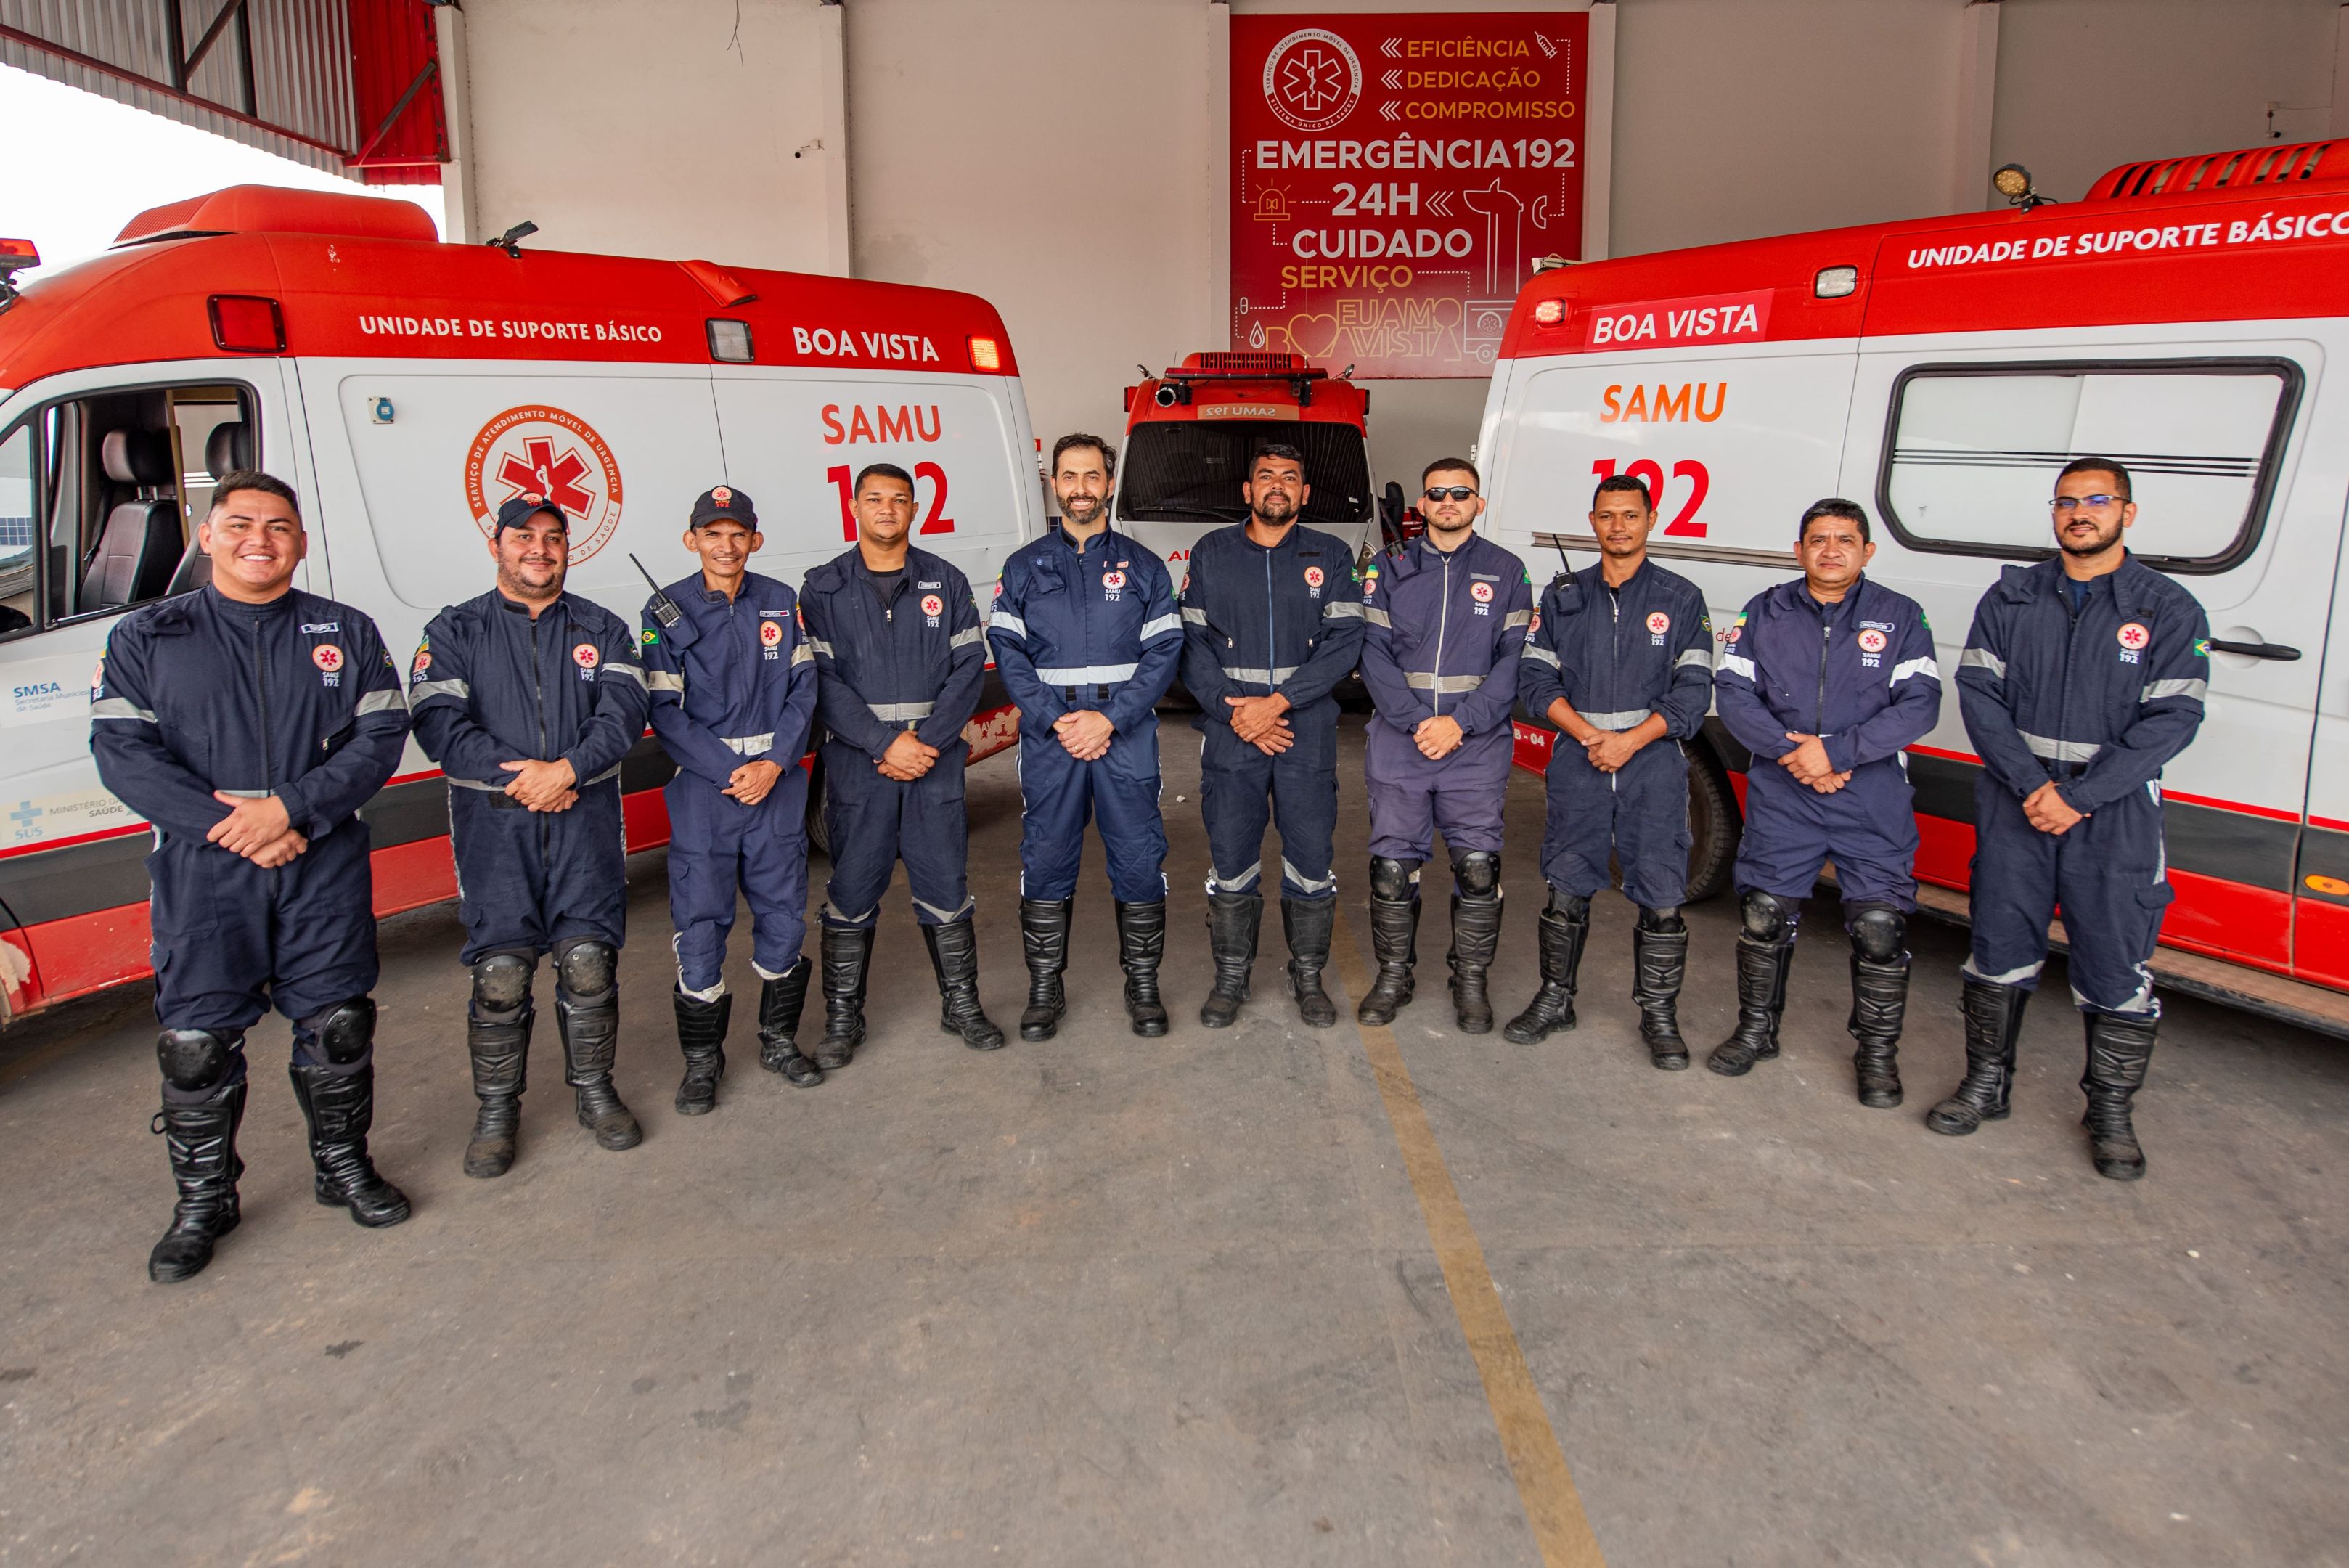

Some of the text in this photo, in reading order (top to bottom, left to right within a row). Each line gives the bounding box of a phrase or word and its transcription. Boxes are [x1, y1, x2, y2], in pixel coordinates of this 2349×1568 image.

[1408, 36, 1529, 57] EFICIÊNCIA
[1279, 32, 1321, 52] ATENDIMENTO
[1323, 34, 1342, 48] MÓVEL
[1349, 56, 1359, 89] URGÊNCIA
[1408, 65, 1540, 92] DEDICAÇÃO
[1270, 99, 1294, 123] SISTEMA
[1336, 99, 1355, 119] SAÚDE
[1405, 100, 1576, 120] COMPROMISSO
[1332, 182, 1418, 216] 24H
[1292, 229, 1473, 259] CUIDADO
[1908, 240, 2027, 269] UNIDADE
[2032, 236, 2068, 258] DE
[2074, 223, 2221, 255] SUPORTE
[1281, 266, 1413, 293] SERVIÇO
[359, 316, 661, 342] UNIDADE DE SUPORTE BÁSICO
[1593, 304, 1758, 344] BOA VISTA
[793, 327, 940, 362] BOA VISTA
[1599, 382, 1728, 423] SAMU
[821, 404, 941, 445] SAMU
[470, 410, 619, 507] SERVIÇO DE ATENDIMENTO MÓVEL DE URGÊNCIA
[827, 461, 955, 542] 12
[580, 511, 616, 556] DE SAÚDE
[1474, 607, 1489, 616] 192
[1861, 658, 1880, 668] 192
[2119, 653, 2138, 664] 192
[14, 682, 61, 698] SMSA
[322, 678, 340, 687] 192
[15, 690, 91, 706] Secretaria Municipa
[29, 702, 51, 711] Saúde
[1529, 732, 1545, 746] 04
[49, 799, 106, 815] MINISTÉRIO
[89, 805, 123, 817] SAÚDE
[15, 826, 44, 840] SUS
